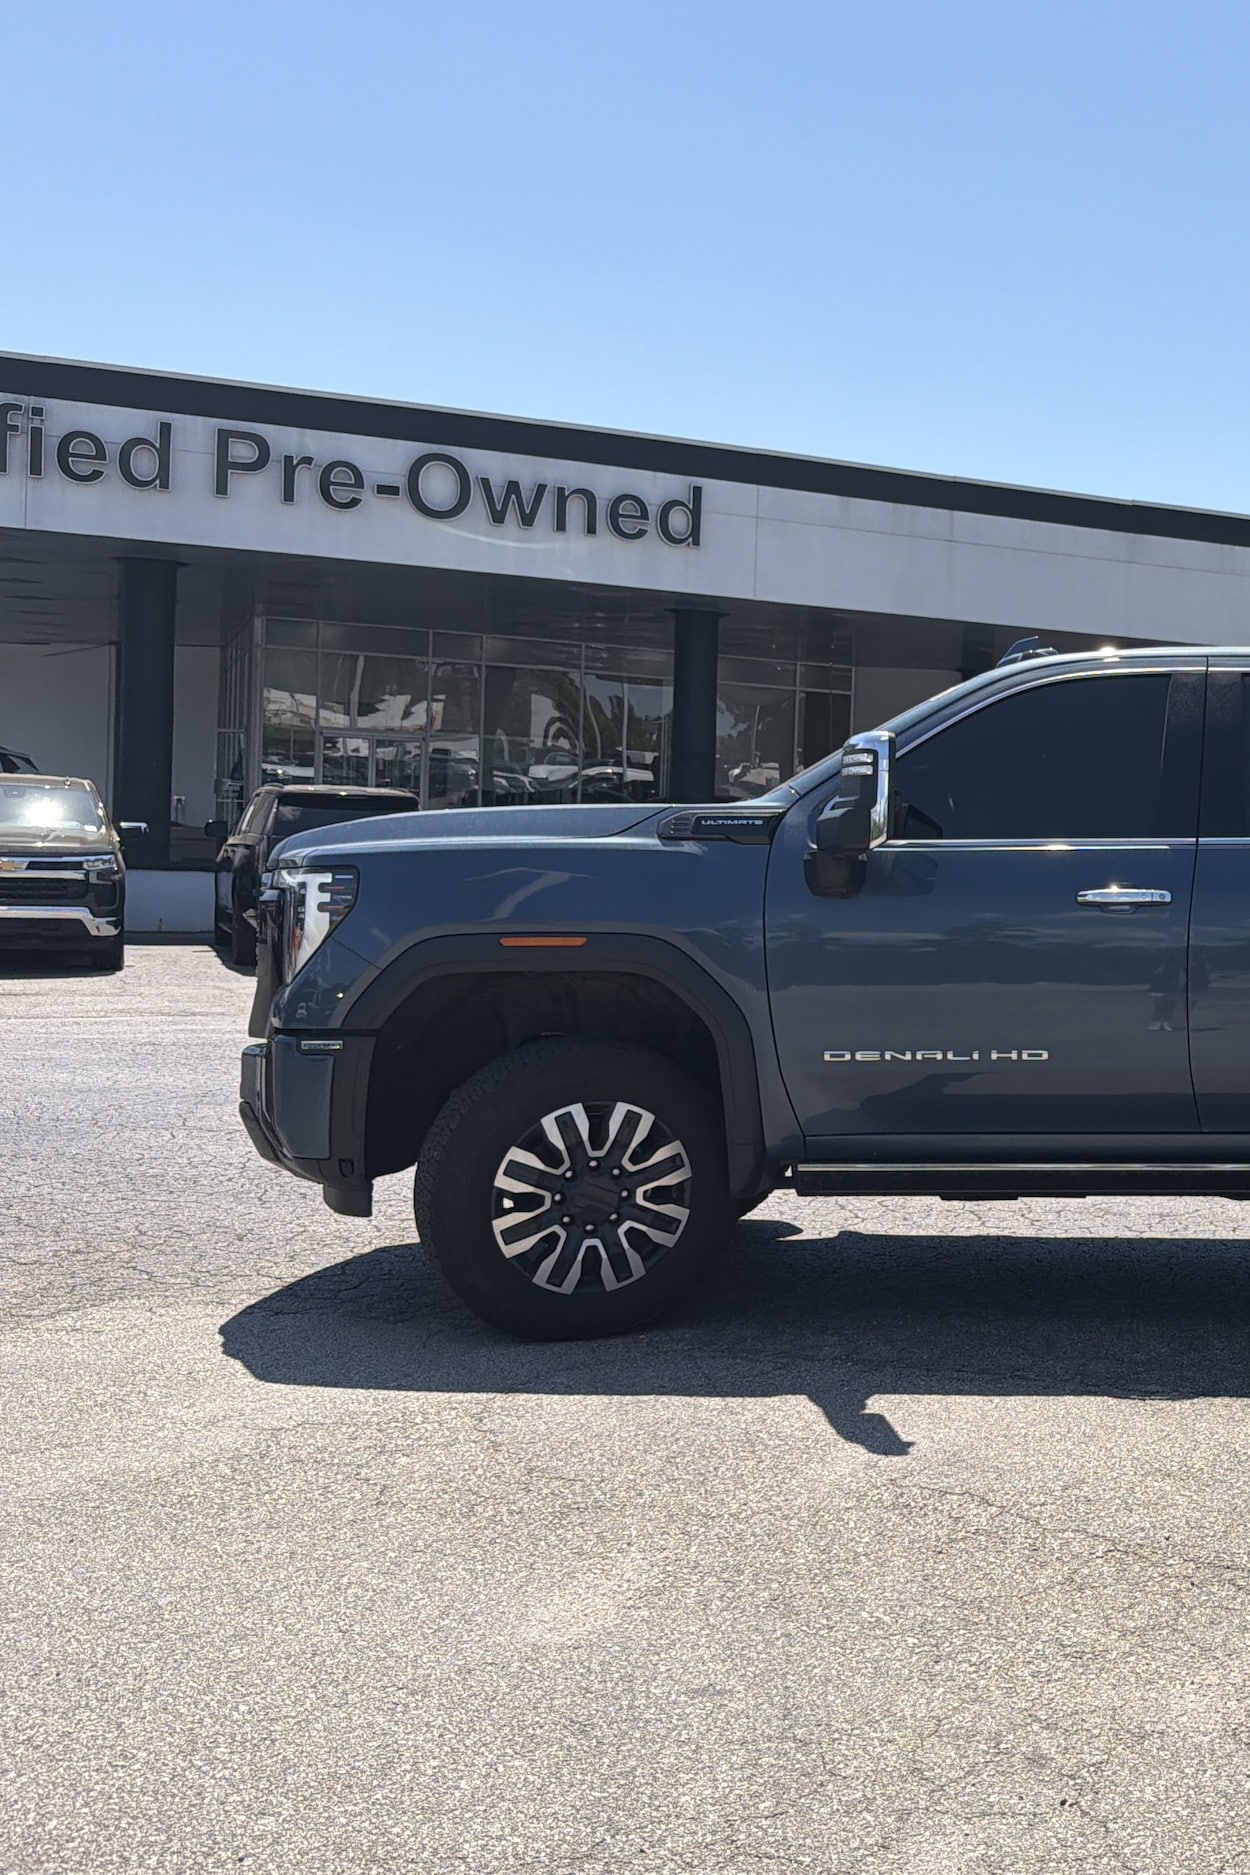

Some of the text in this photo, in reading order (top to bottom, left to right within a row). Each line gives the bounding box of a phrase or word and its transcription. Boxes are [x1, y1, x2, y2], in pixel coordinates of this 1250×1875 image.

[213, 427, 703, 548] Pre-Owned
[823, 1049, 1050, 1062] DENALI HD
